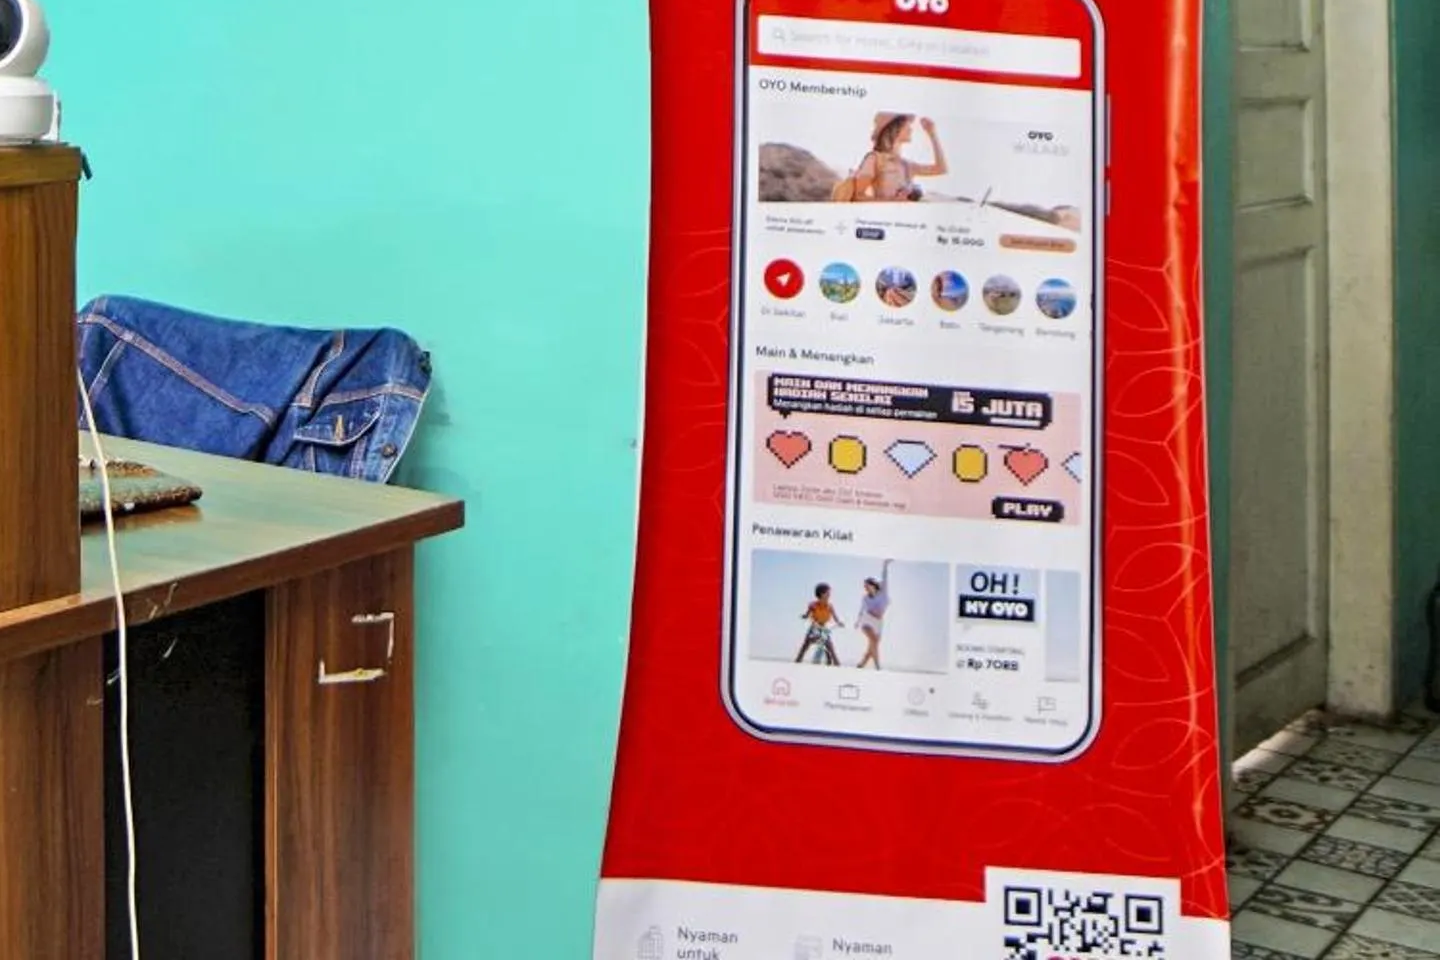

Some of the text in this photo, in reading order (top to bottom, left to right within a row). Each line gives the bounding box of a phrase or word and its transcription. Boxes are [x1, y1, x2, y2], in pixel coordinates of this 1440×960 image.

[759, 78, 867, 98] OYO Membership
[755, 345, 875, 365] Main & Menangkan
[981, 399, 1043, 418] JUTA
[1002, 502, 1053, 517] PLAY
[752, 523, 853, 541] Penawaran Kilat
[970, 571, 1020, 595] OH!
[991, 601, 1028, 618] OYO
[967, 658, 984, 671] Rp
[677, 926, 738, 944] Nyaman
[677, 947, 721, 960] untuk
[832, 937, 893, 956] Nyaman
